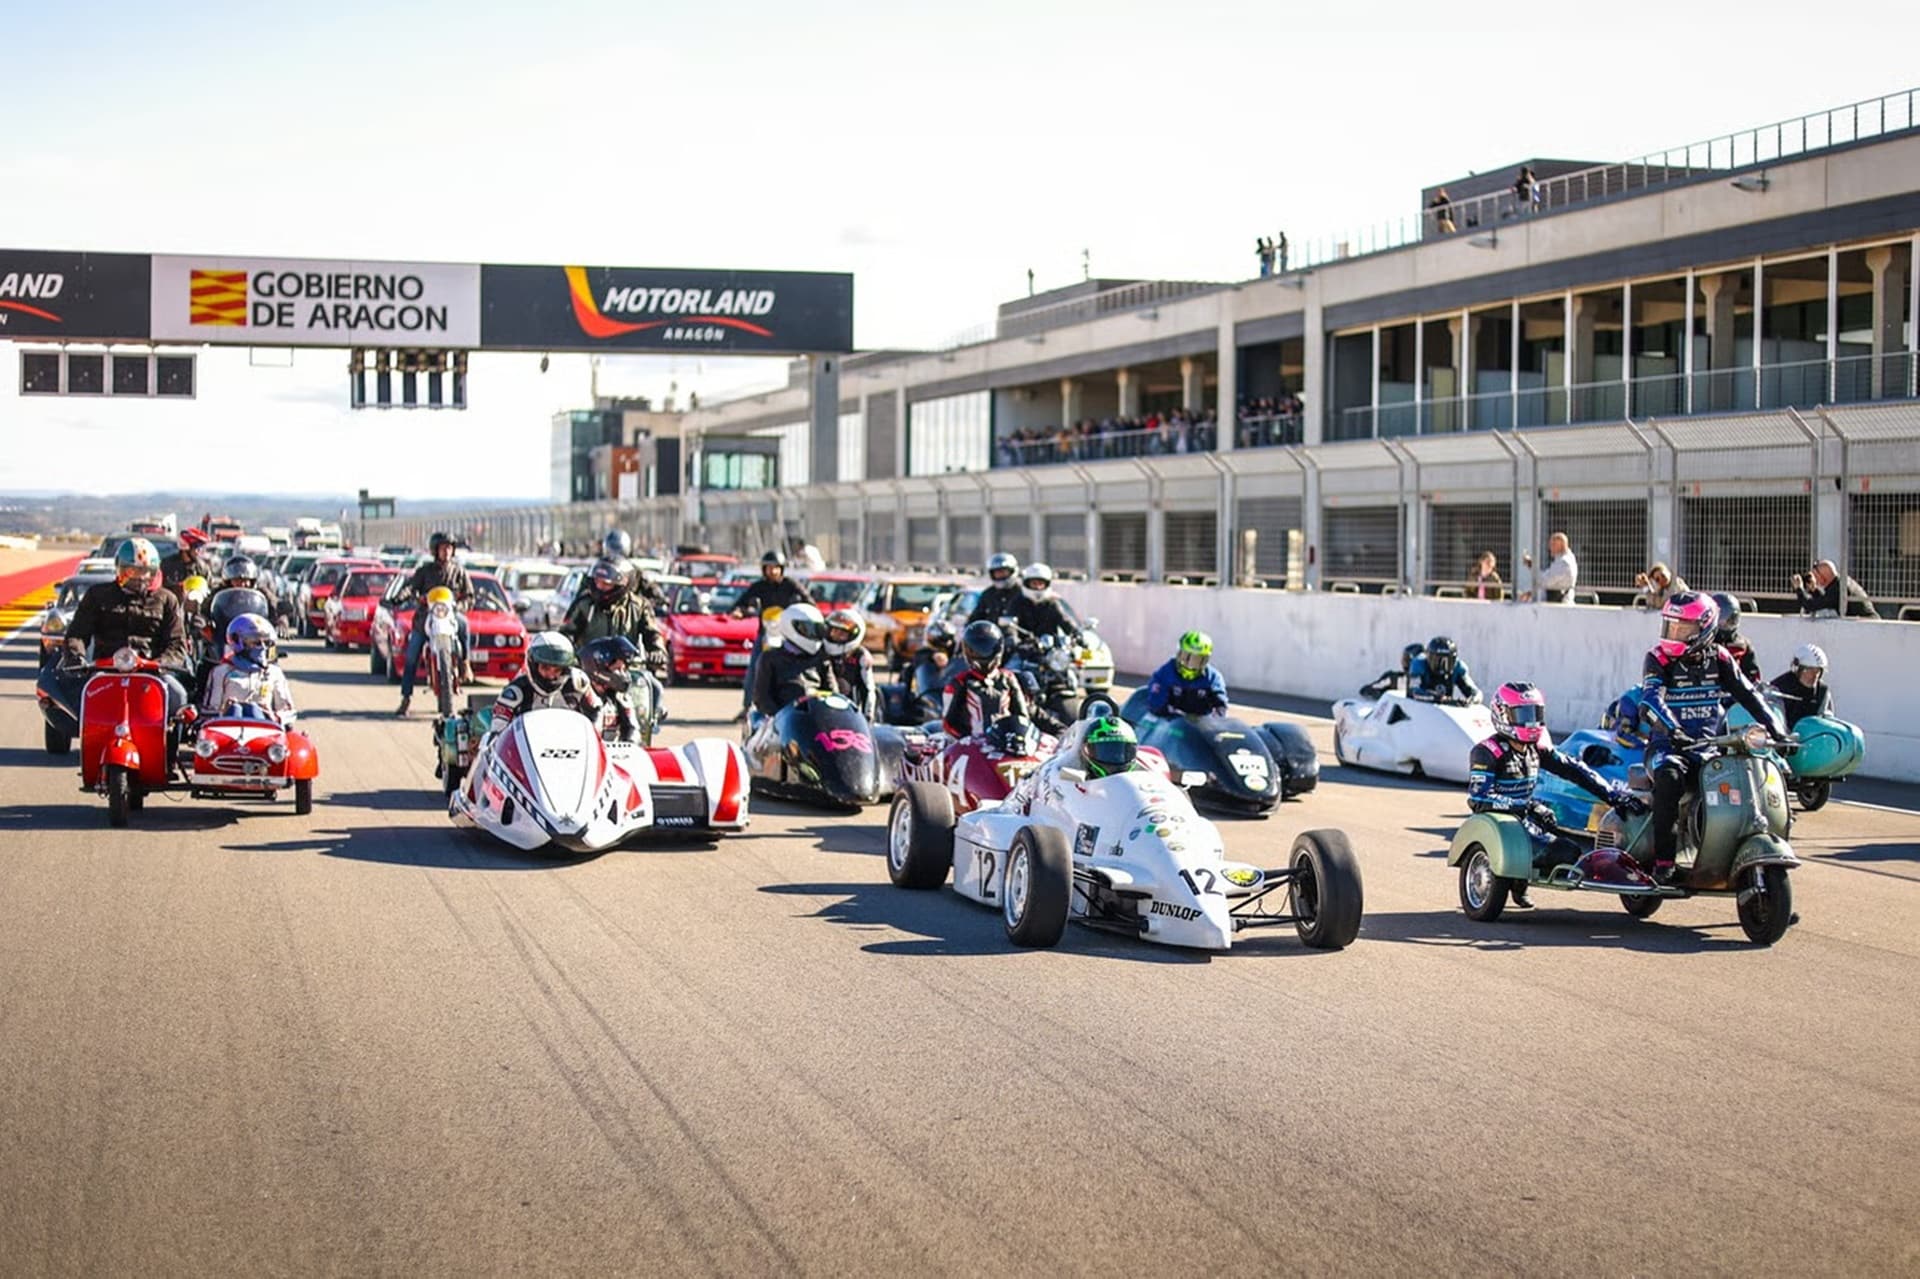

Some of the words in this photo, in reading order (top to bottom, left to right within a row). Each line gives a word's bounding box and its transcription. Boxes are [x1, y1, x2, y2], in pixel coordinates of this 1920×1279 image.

[252, 271, 425, 301] GOBIERNO
[602, 286, 776, 315] MOTORLAND
[252, 301, 295, 328] DE
[308, 303, 448, 332] ARAGON
[663, 326, 725, 342] ARAGÓN
[540, 748, 580, 759] 222
[975, 850, 997, 899] 12
[1178, 868, 1223, 896] 12
[1150, 901, 1203, 922] DUNLOP
